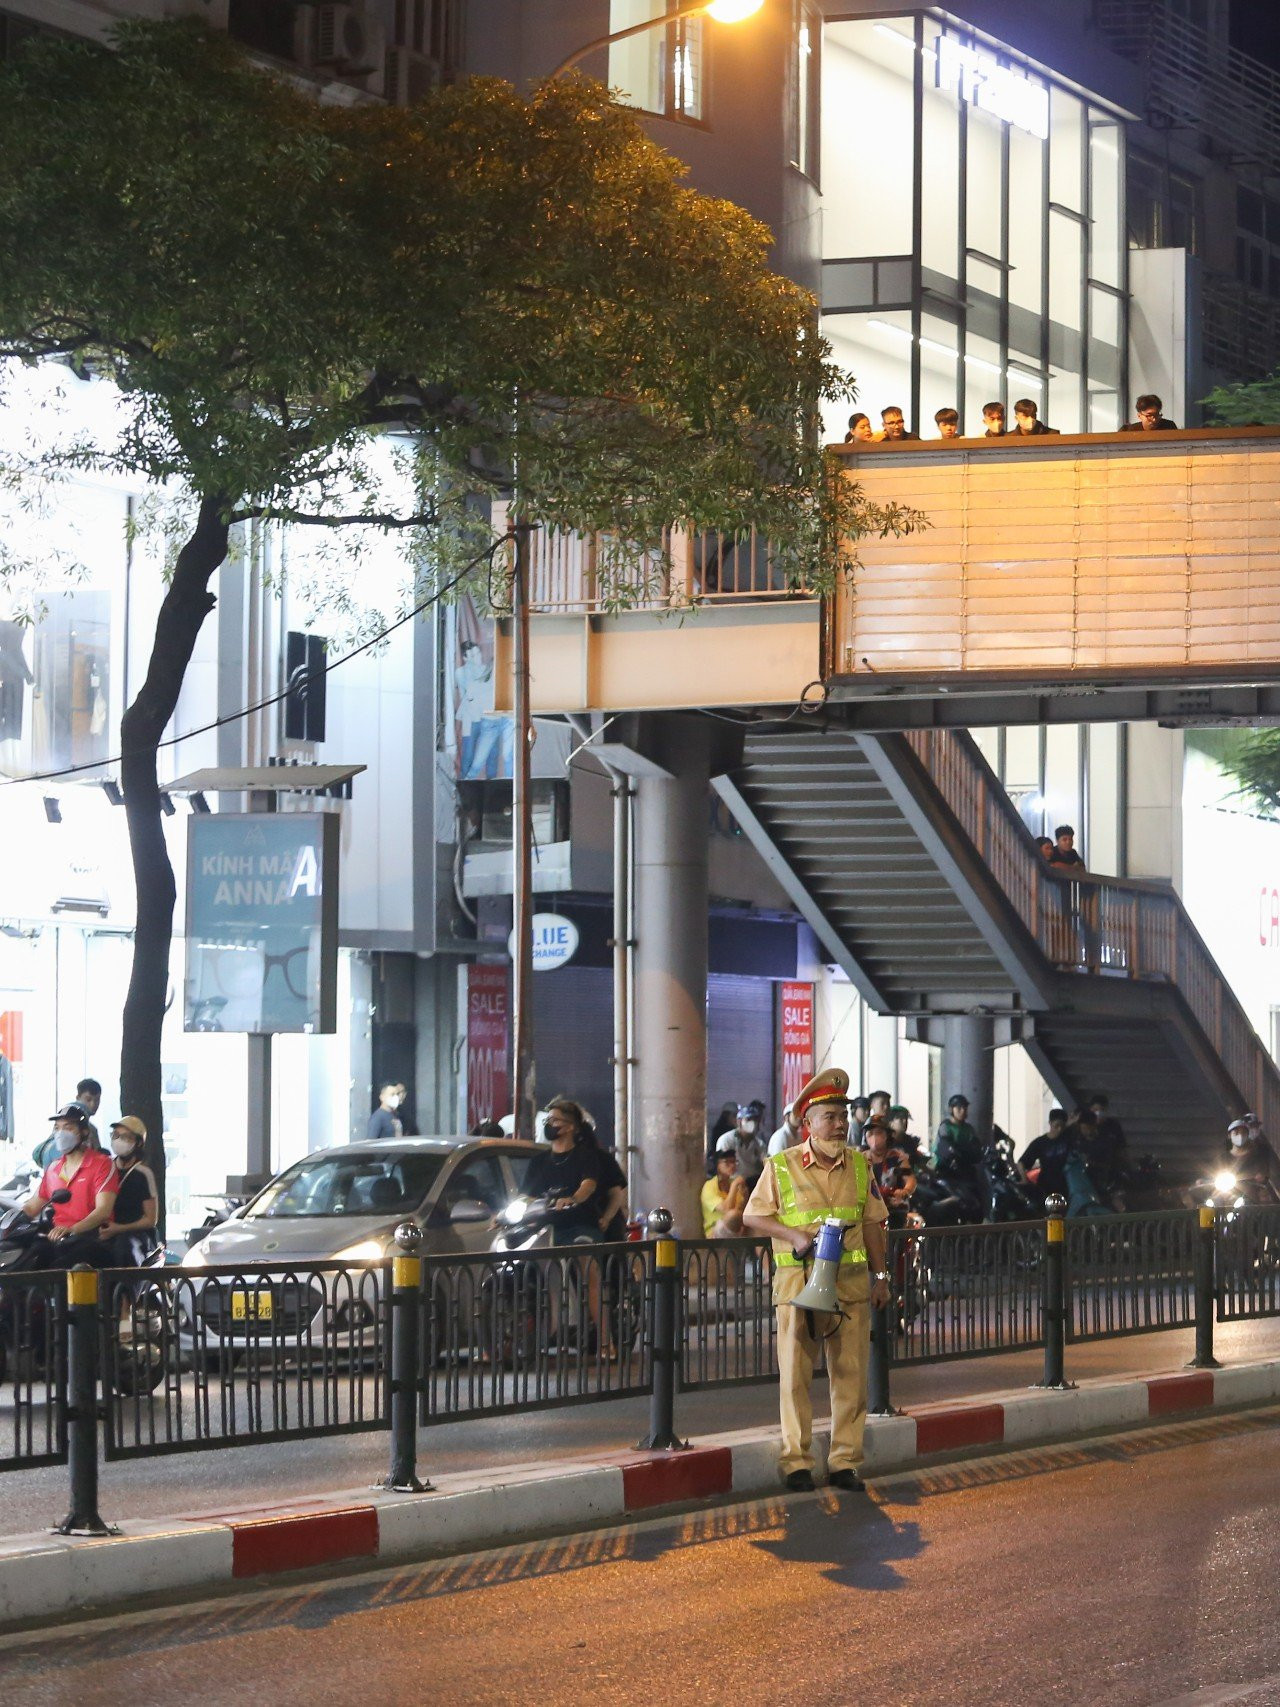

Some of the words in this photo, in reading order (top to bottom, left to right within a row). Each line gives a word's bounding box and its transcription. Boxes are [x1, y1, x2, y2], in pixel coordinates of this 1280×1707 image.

[202, 851, 253, 876] KÍNH
[213, 880, 294, 905] ANNA
[531, 926, 569, 945] LUE
[531, 947, 567, 959] CHANGE
[471, 992, 506, 1013] SALE
[784, 1006, 810, 1026] SALE
